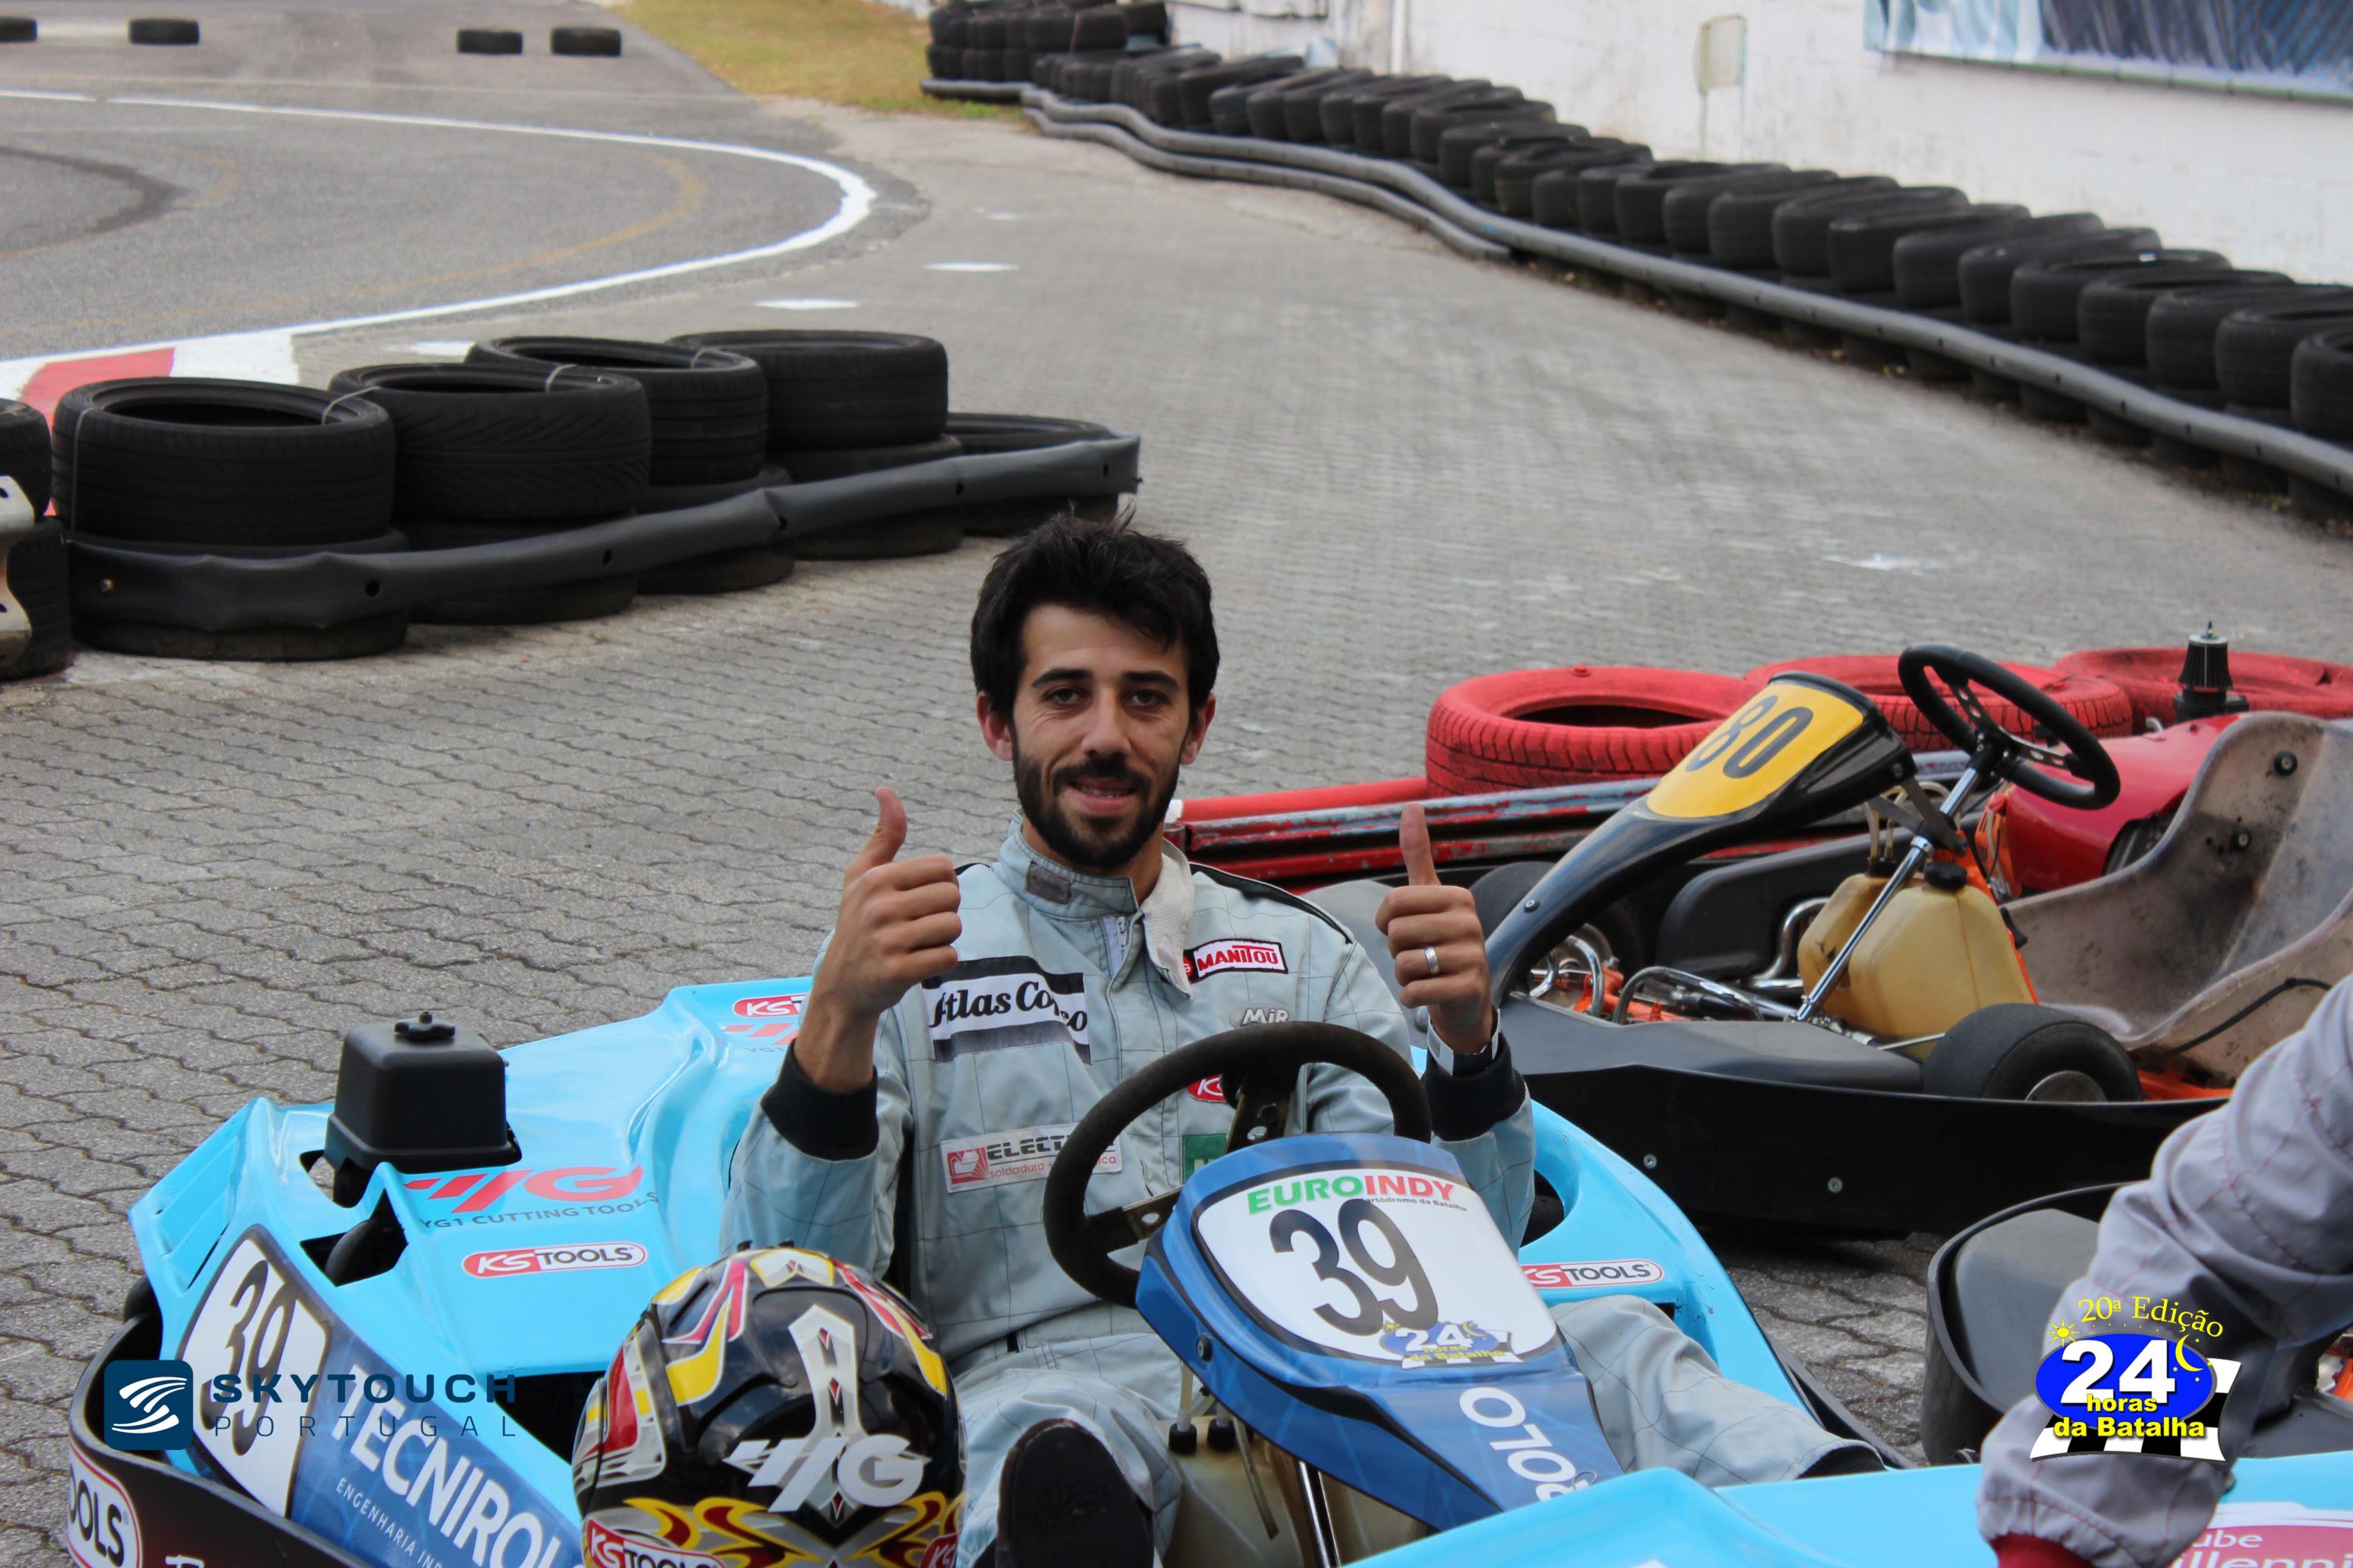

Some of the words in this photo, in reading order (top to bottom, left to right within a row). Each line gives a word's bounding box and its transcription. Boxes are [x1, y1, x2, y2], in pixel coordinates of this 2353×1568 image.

[1685, 695, 1814, 779] 80
[1197, 945, 1279, 971] MANITOU
[1015, 981, 1088, 1032] Coo
[472, 1207, 579, 1225] CUTTING
[582, 1191, 660, 1215] TOOLS
[1247, 1175, 1454, 1215] EUROINDY
[1268, 1197, 1438, 1337] 39
[200, 1259, 297, 1457] 39
[1395, 1324, 1474, 1352] 24
[336, 1478, 416, 1557] ENGENHARIA
